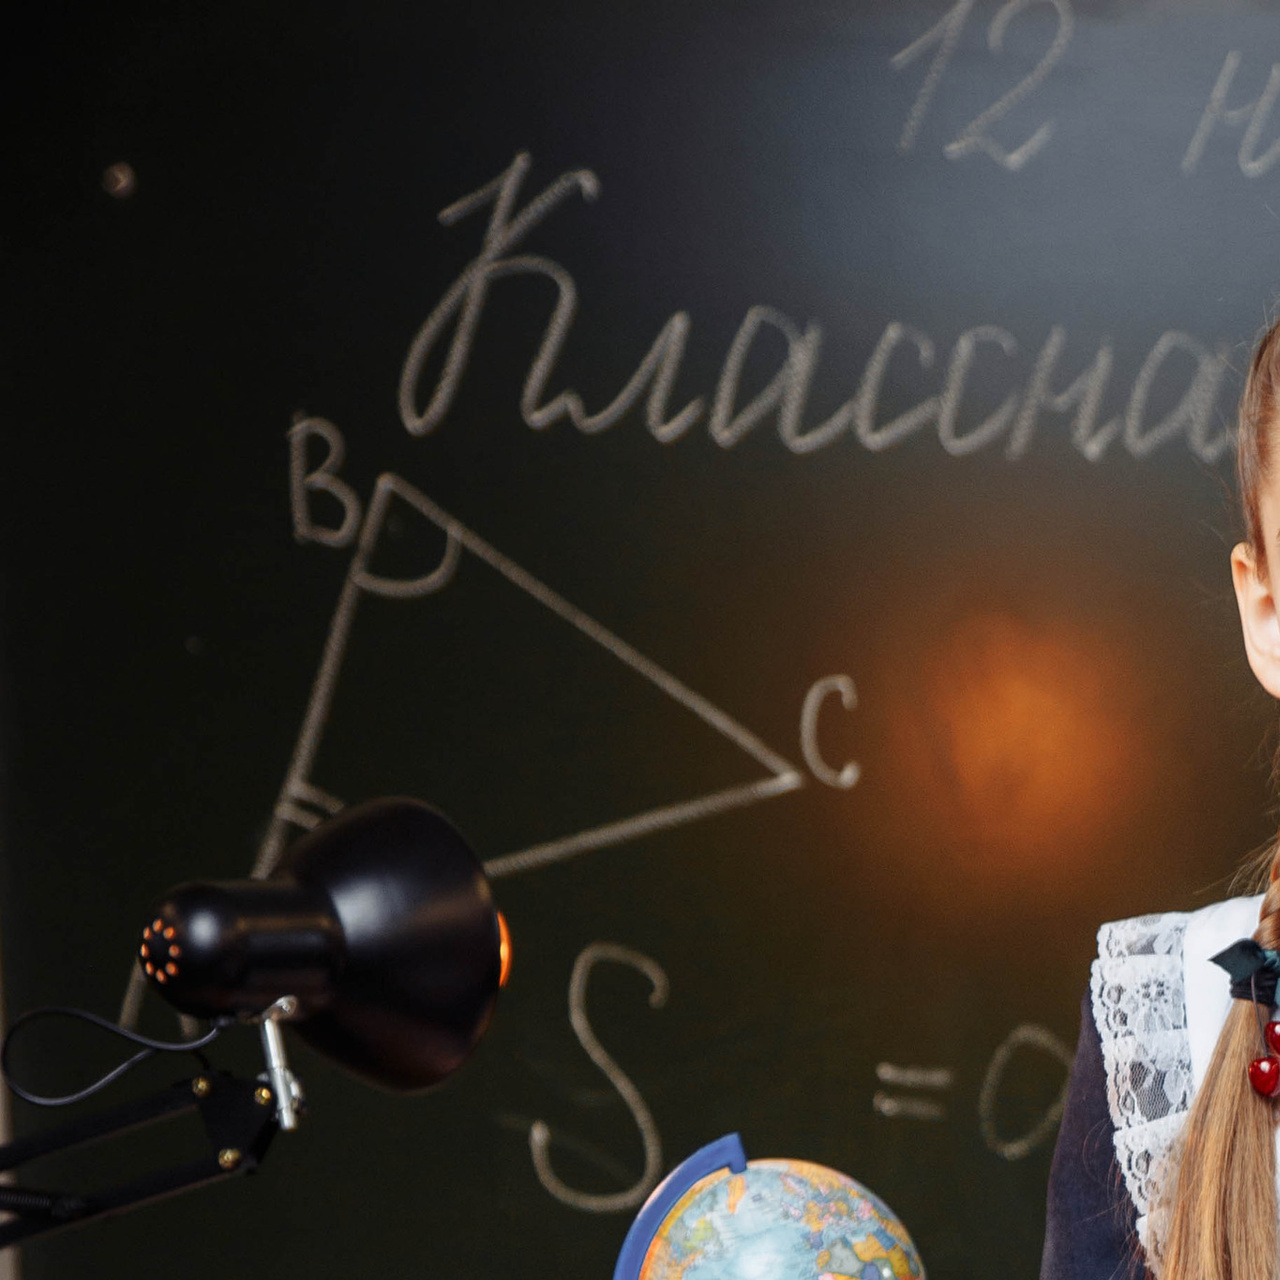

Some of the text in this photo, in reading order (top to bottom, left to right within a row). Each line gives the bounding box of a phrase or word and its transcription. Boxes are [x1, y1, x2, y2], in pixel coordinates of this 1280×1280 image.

[888, 0, 1076, 170] 12
[400, 150, 1243, 462] Классна
[529, 941, 670, 1214] S
